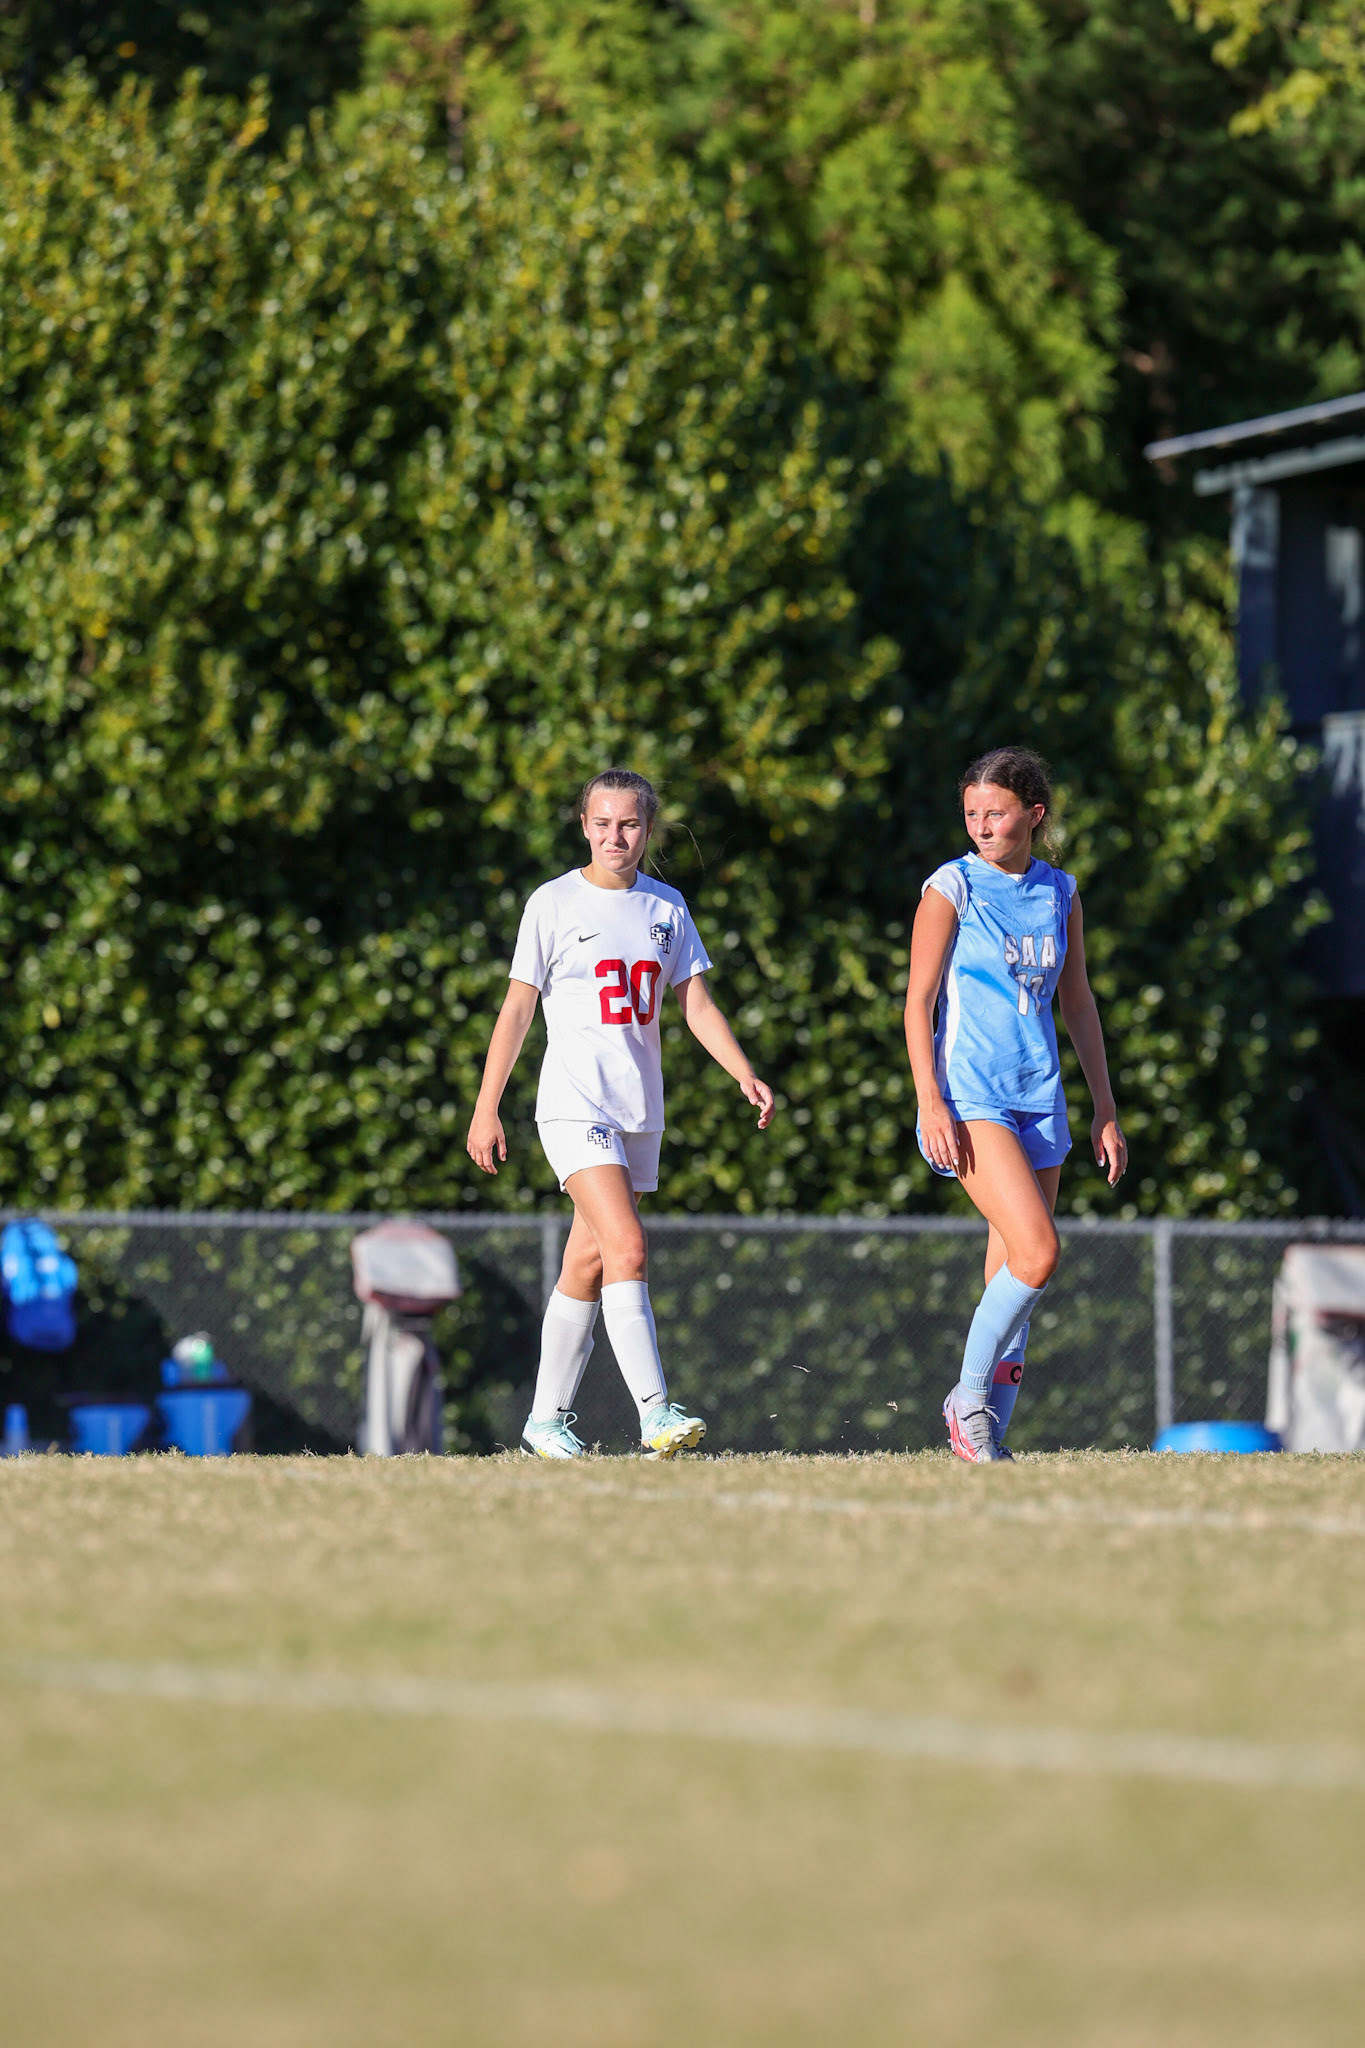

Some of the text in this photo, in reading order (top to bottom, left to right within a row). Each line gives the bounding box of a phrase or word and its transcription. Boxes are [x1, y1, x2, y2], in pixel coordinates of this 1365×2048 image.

[650, 926, 672, 954] SBA
[1004, 935, 1056, 969] SAA
[594, 959, 662, 1025] 20
[587, 1129, 612, 1149] SBA
[1009, 1365, 1022, 1384] C
